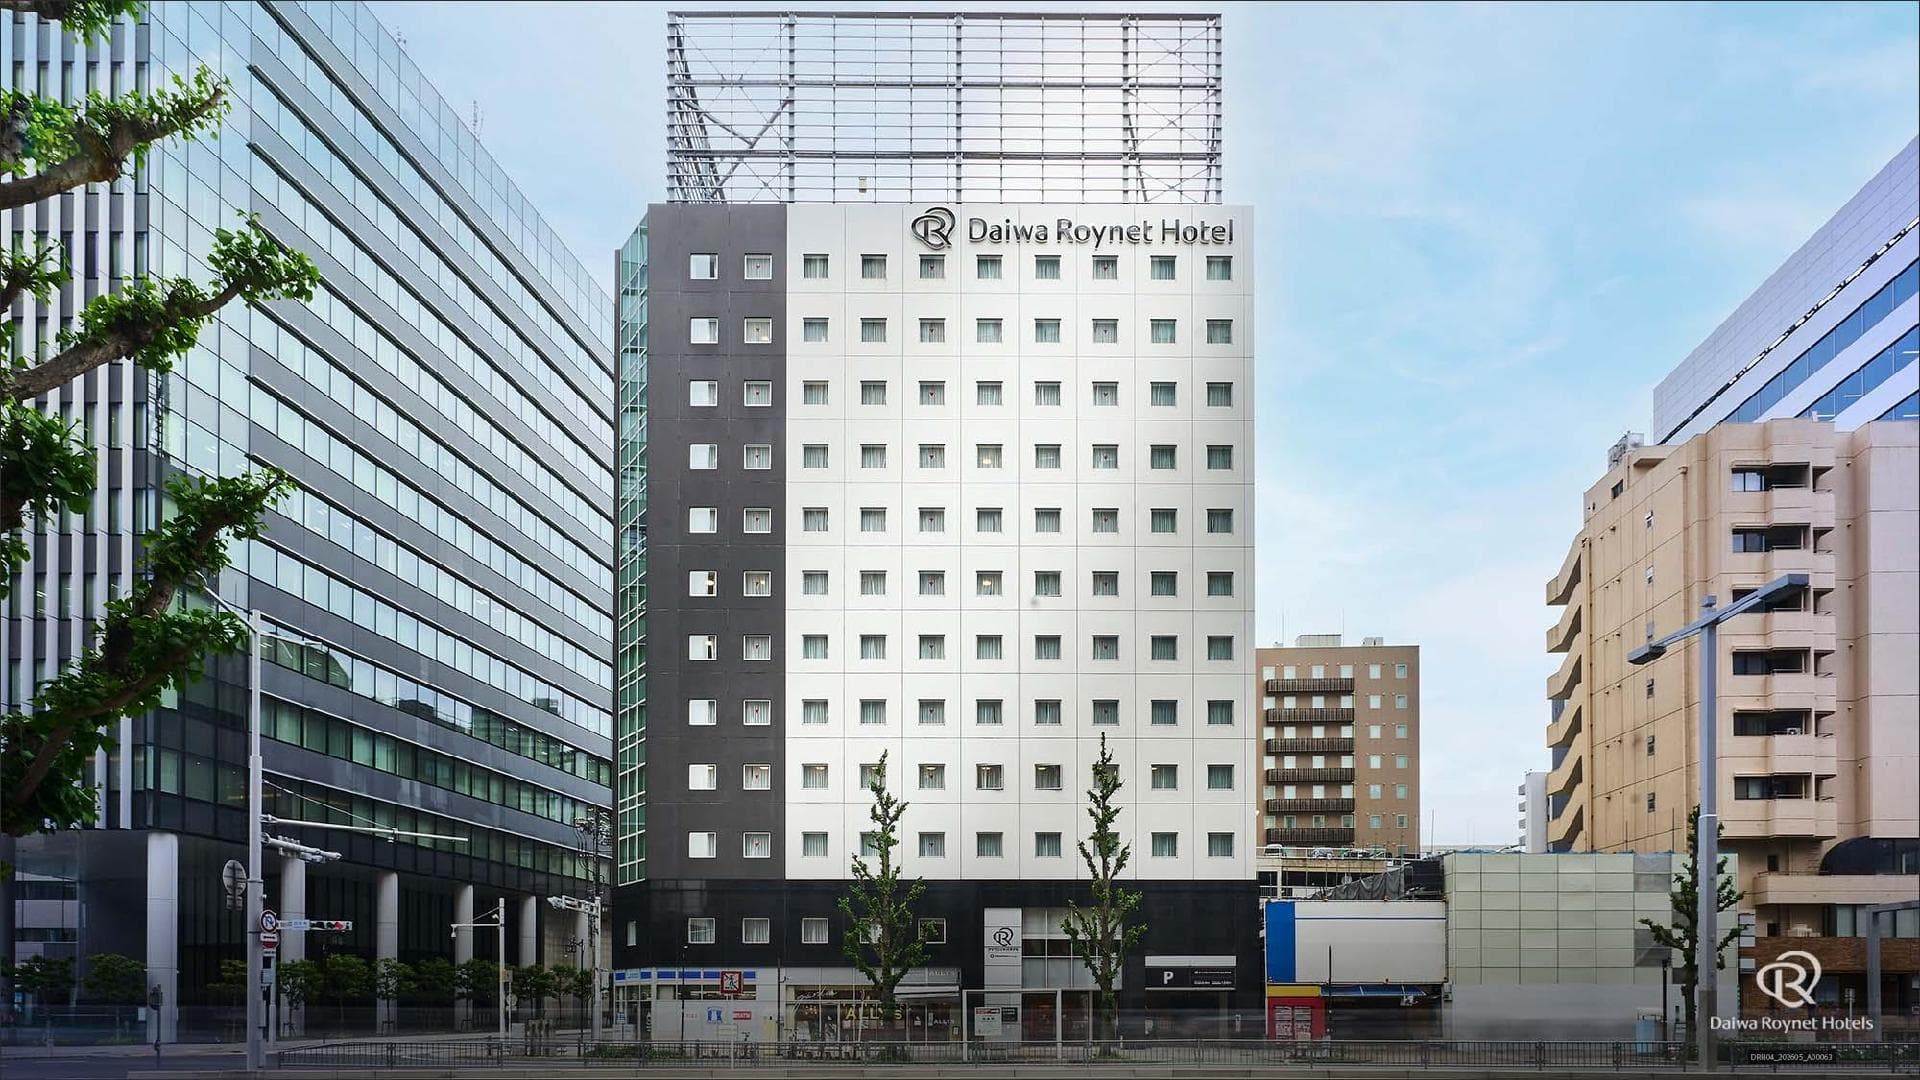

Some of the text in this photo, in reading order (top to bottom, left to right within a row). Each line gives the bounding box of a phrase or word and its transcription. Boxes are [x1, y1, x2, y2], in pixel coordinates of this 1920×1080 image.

[968, 218, 1234, 250] Daiwa Roynet Hotel
[1163, 971, 1174, 985] P
